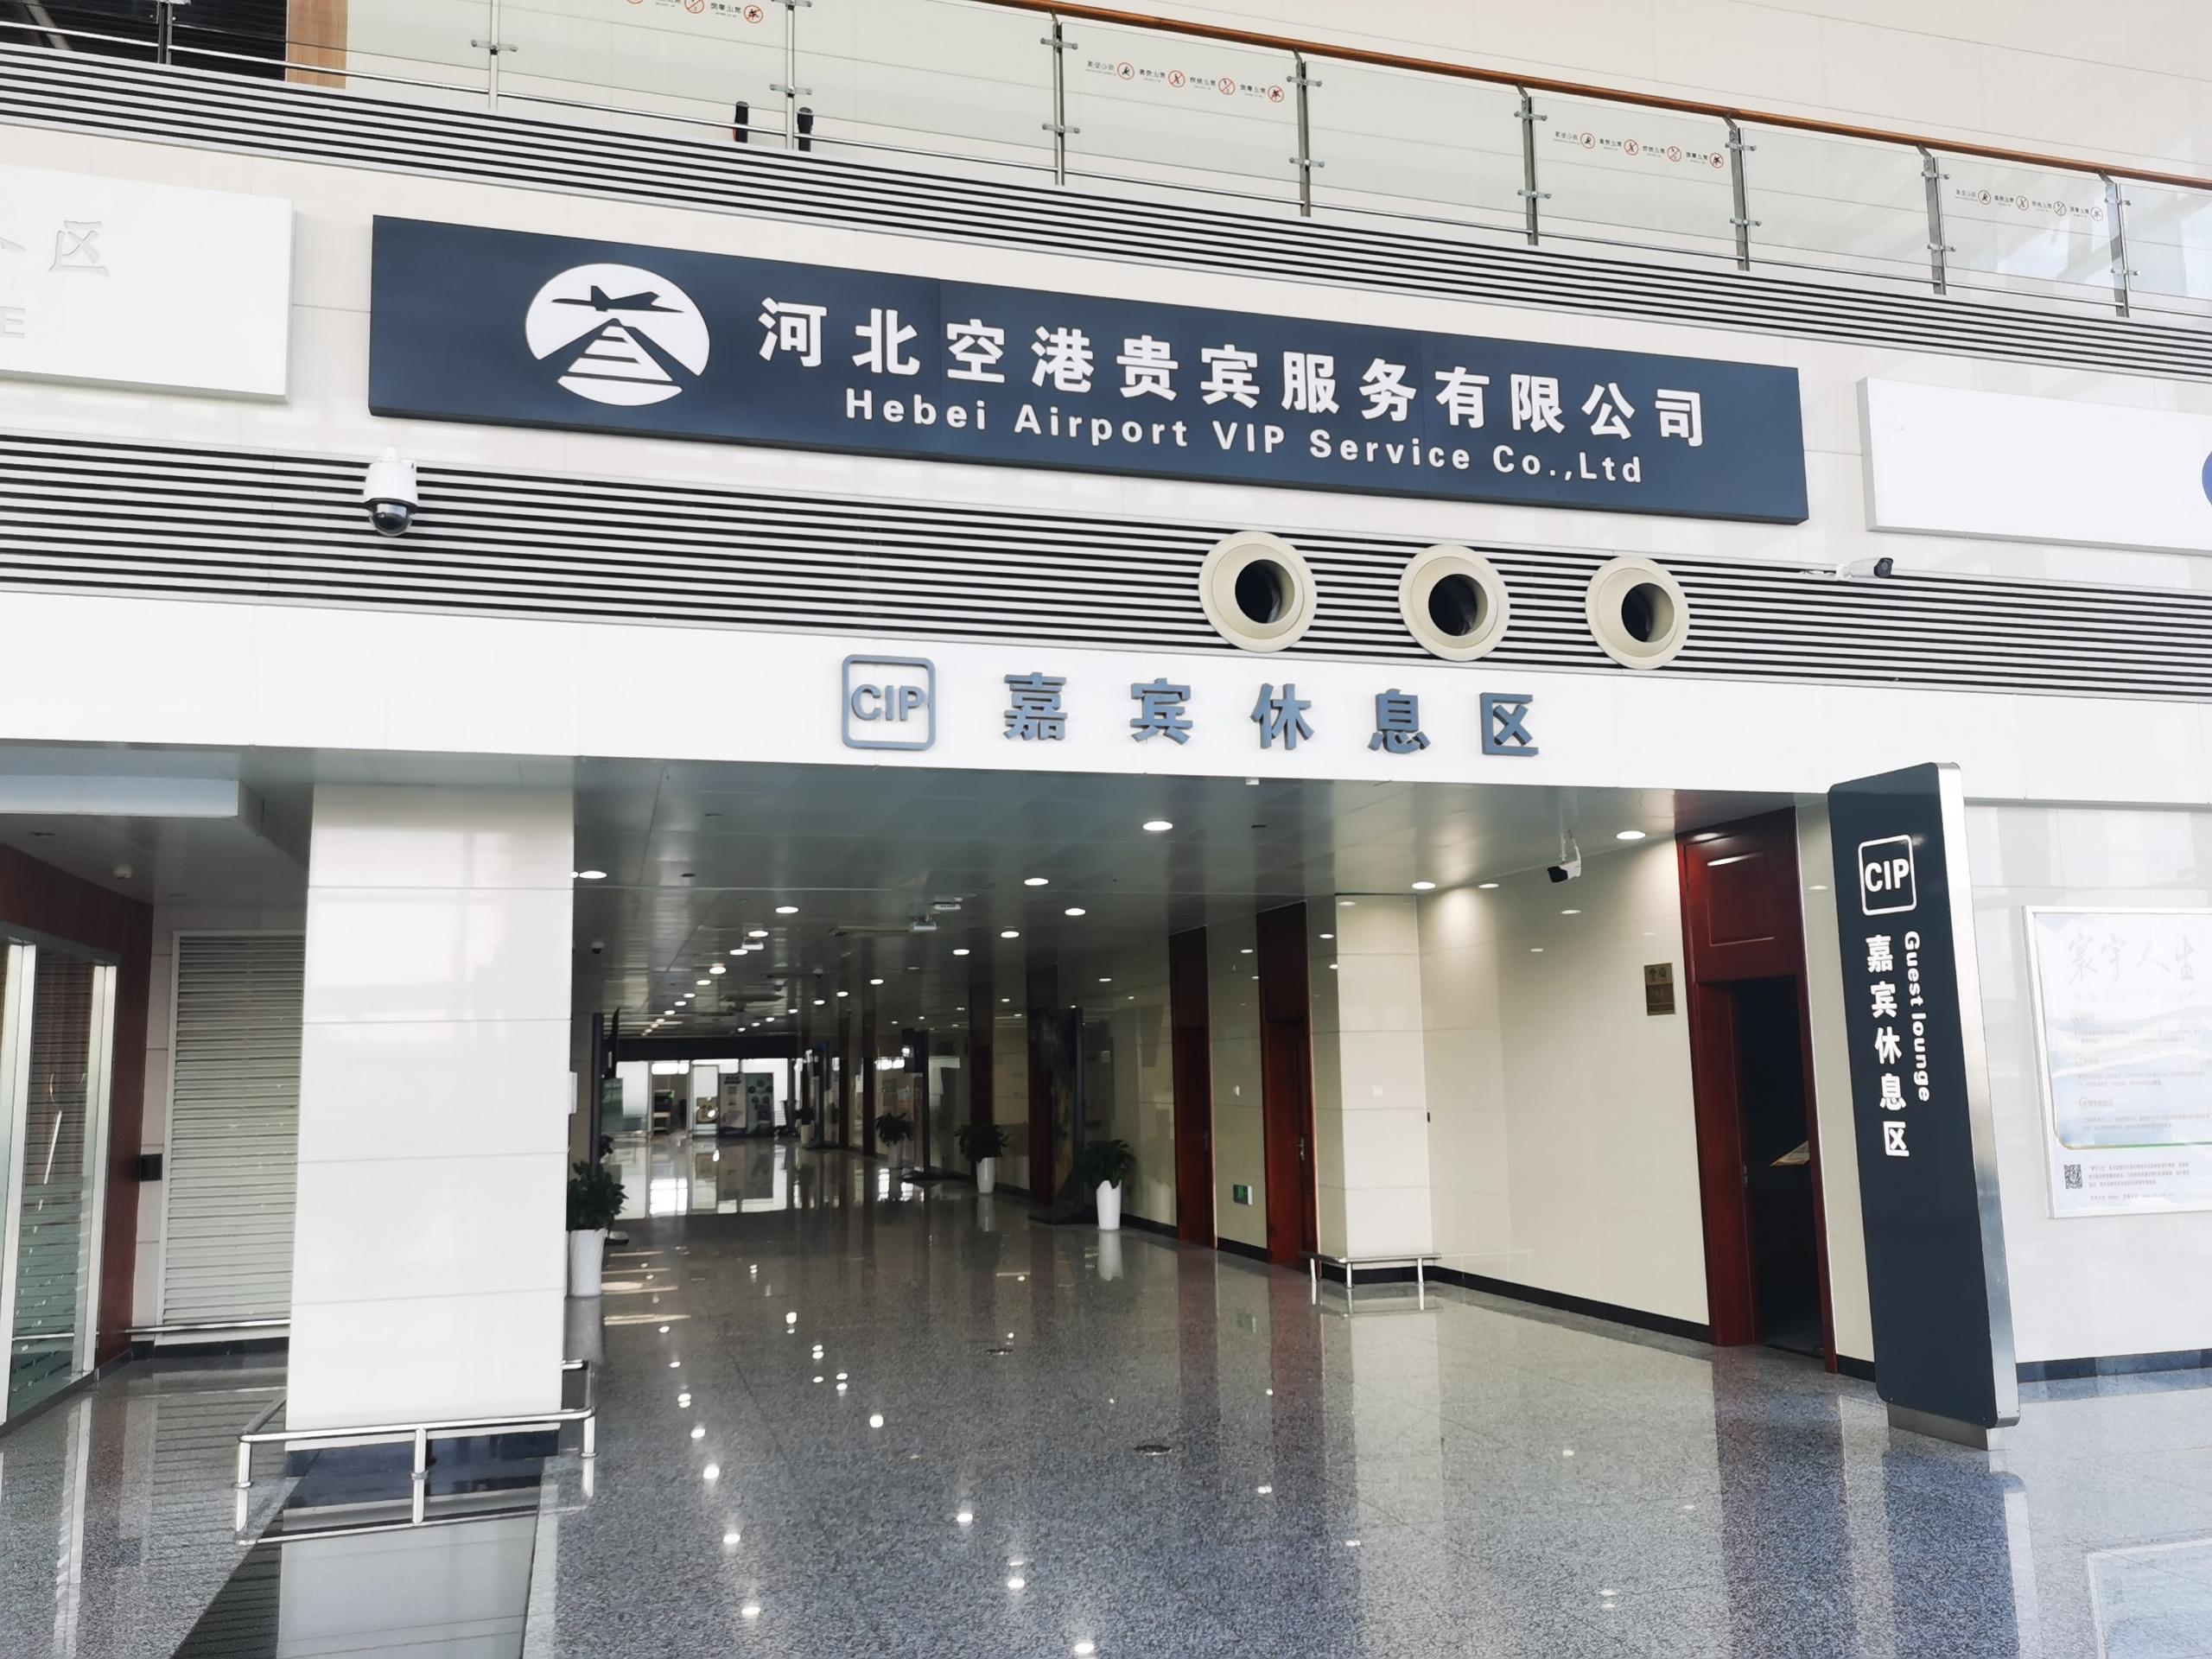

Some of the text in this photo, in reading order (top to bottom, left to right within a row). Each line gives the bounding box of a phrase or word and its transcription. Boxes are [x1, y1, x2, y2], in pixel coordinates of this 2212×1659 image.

[759, 297, 1703, 447] 河北空港贵宾服务有限公司
[846, 388, 1642, 483] Hebei Airport VIP Service Co.,Ltd
[851, 683, 926, 721] CIP
[1002, 671, 1540, 757] 嘉宾休息区
[1865, 858, 1910, 893] CIP
[1866, 934, 1910, 1157] 嘉宾休息区
[1904, 931, 1930, 1103] Guest lounge
